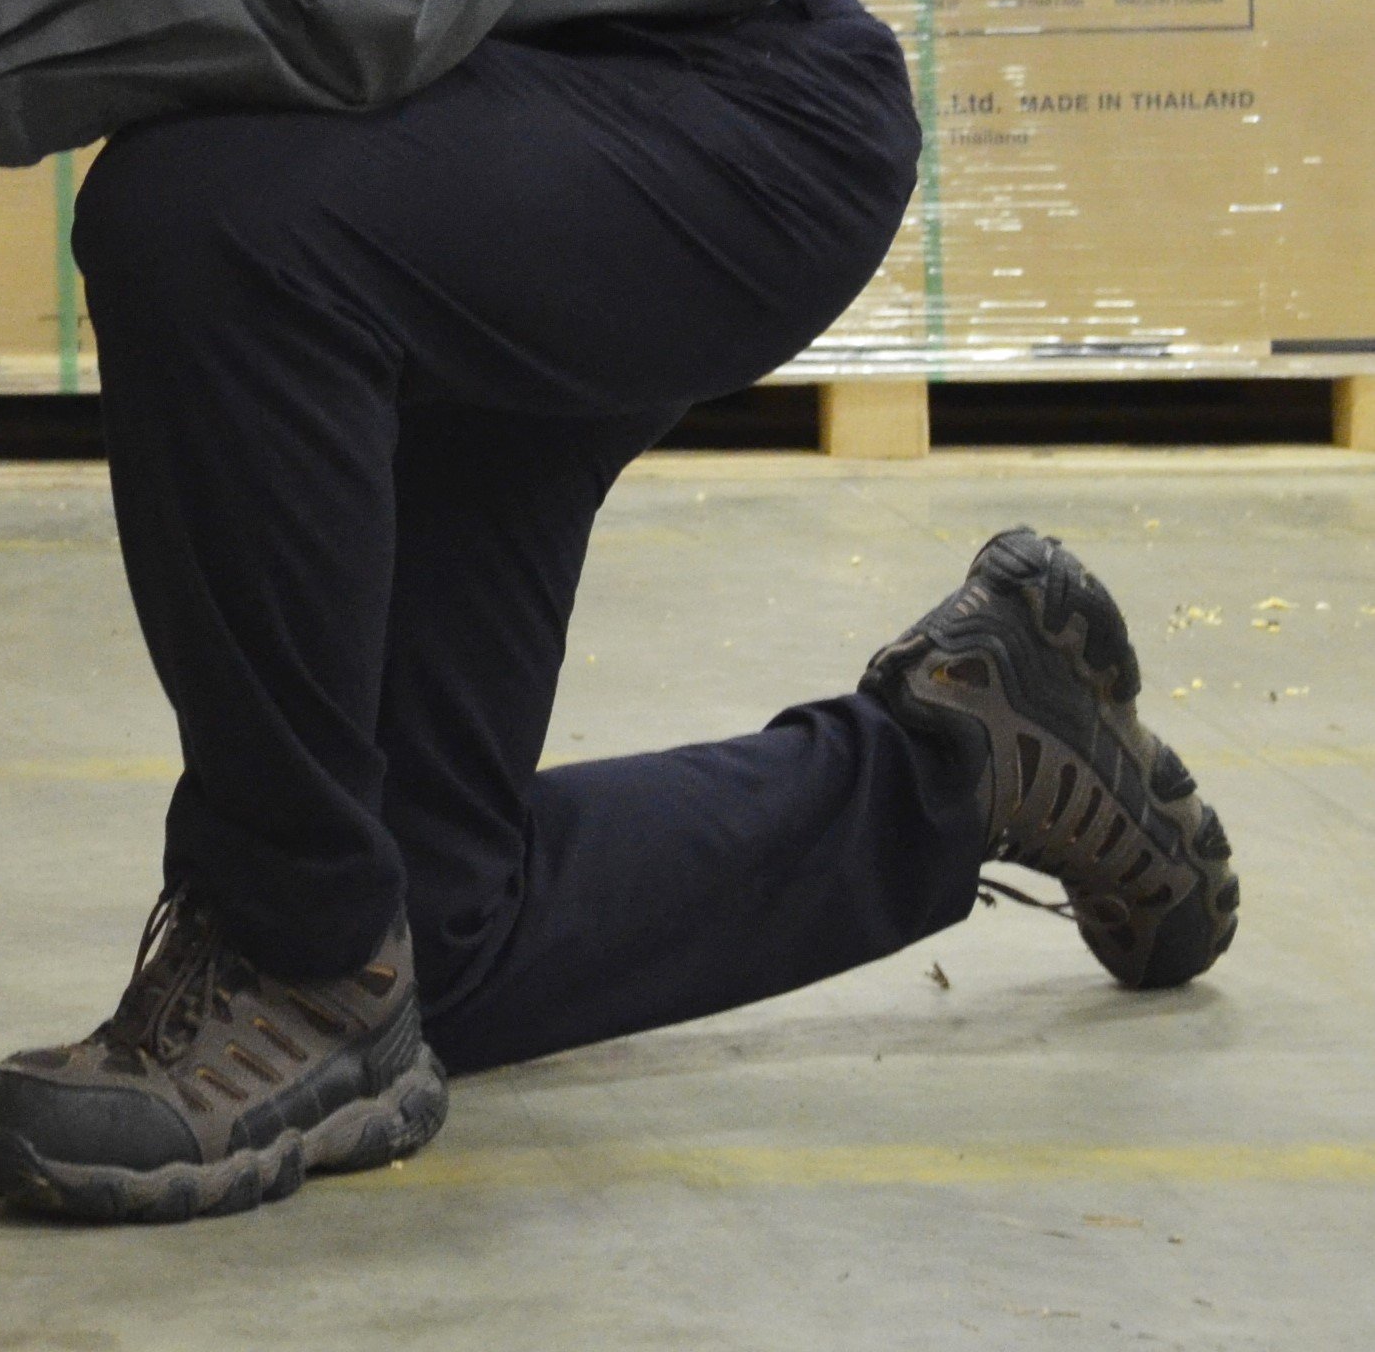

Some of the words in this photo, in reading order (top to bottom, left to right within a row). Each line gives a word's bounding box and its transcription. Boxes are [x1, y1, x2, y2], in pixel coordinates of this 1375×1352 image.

[1020, 93, 1089, 114] MADE
[1098, 92, 1122, 112] IN
[1130, 89, 1256, 111] THAILAND
